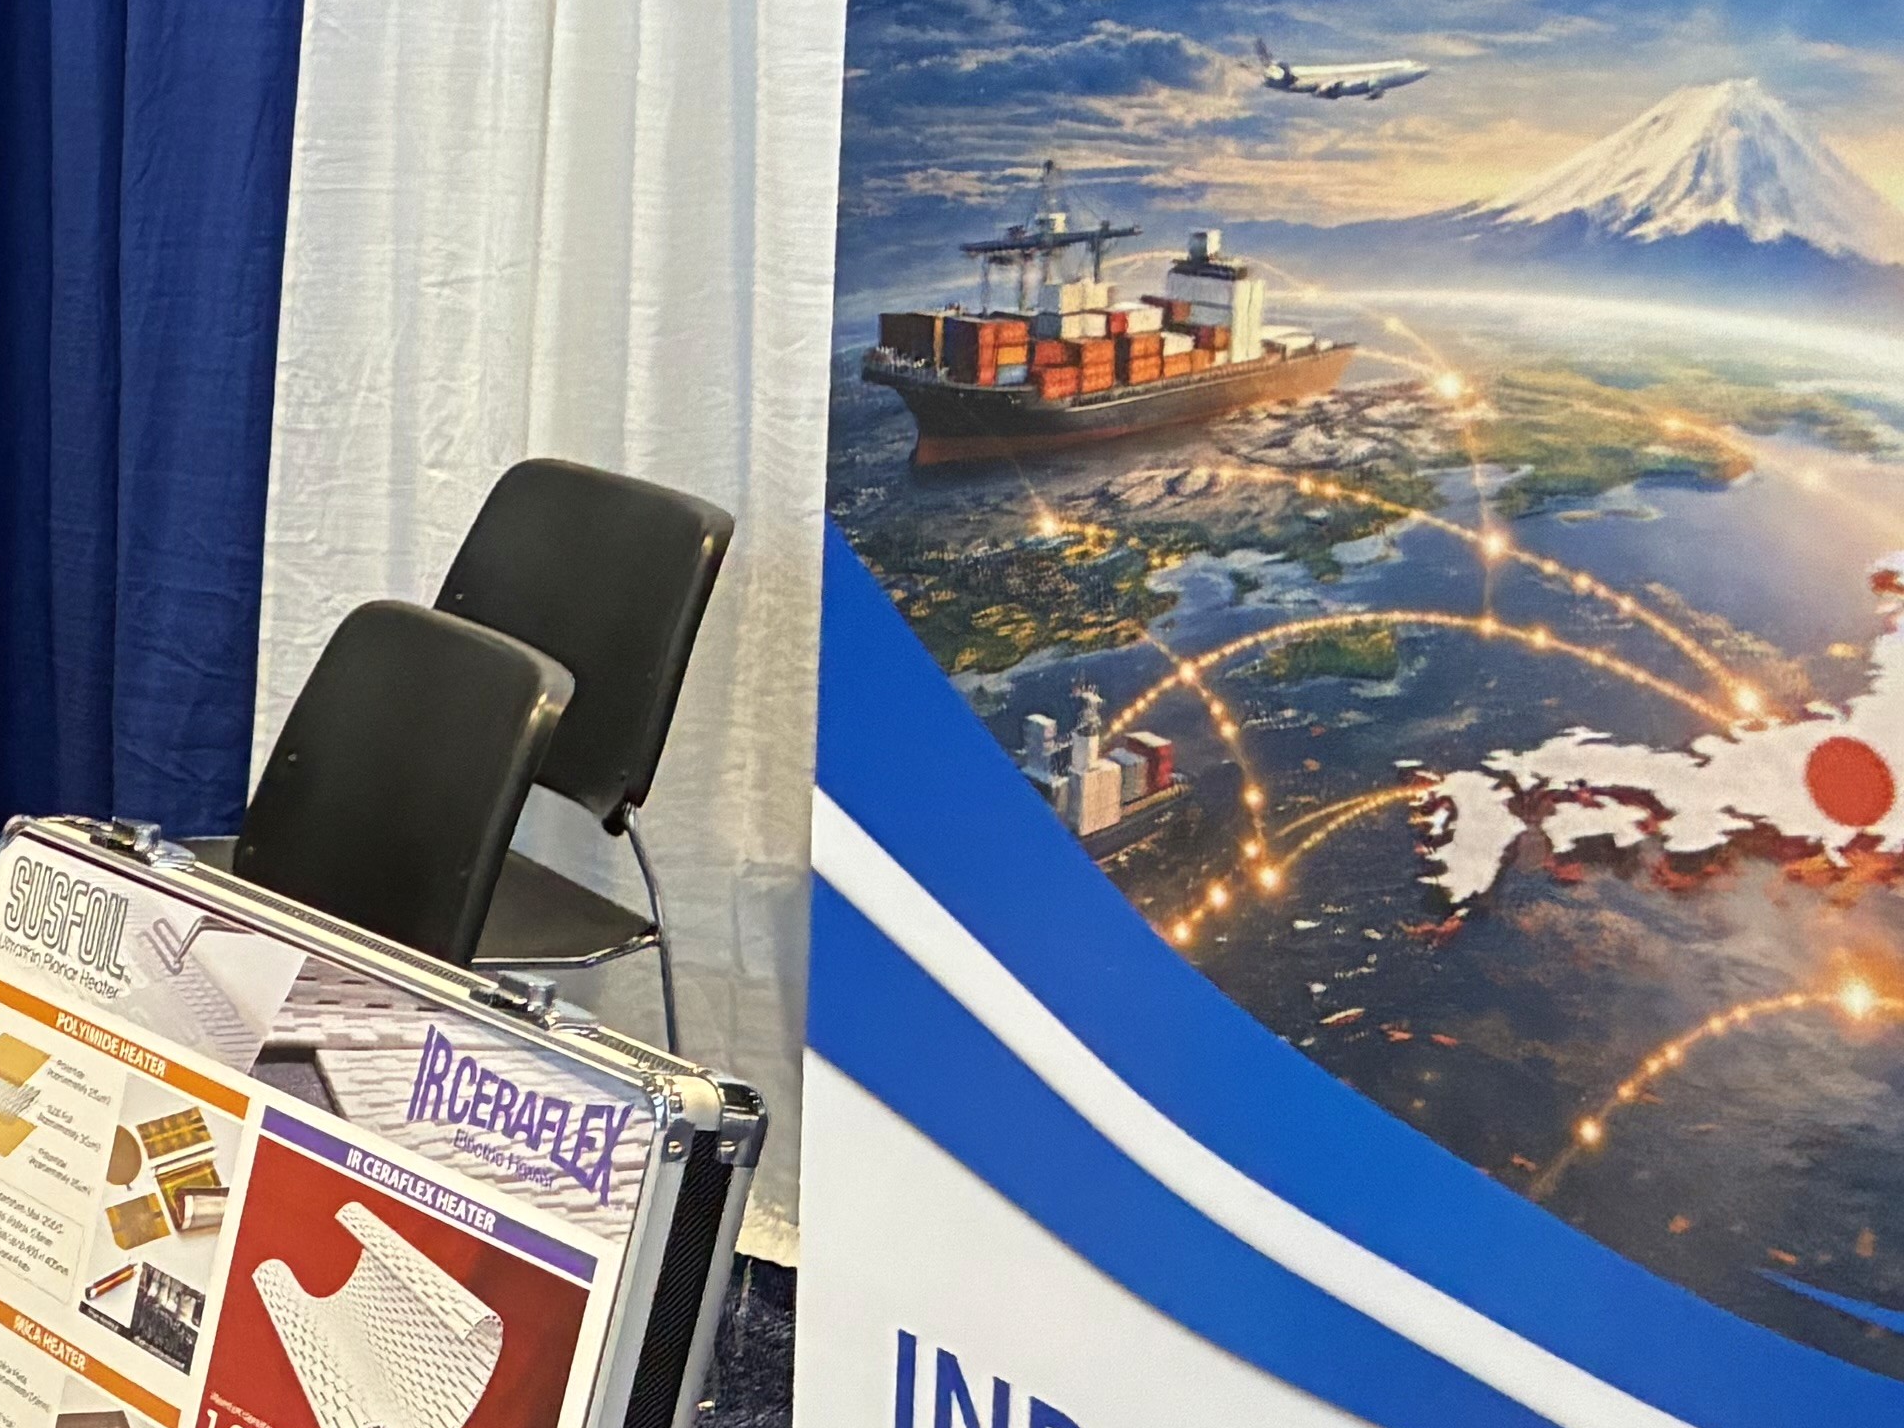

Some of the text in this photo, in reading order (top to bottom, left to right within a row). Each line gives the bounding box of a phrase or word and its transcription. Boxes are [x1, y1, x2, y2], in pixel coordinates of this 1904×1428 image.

[4, 856, 129, 981] SUSFOIL
[56, 1012, 167, 1077] POLYIMIDE HEATER
[407, 1023, 635, 1207] IR CERAFLEX
[346, 1148, 497, 1233] IR CERAFLEX HEATER
[13, 1315, 87, 1372] MICA HEATER
